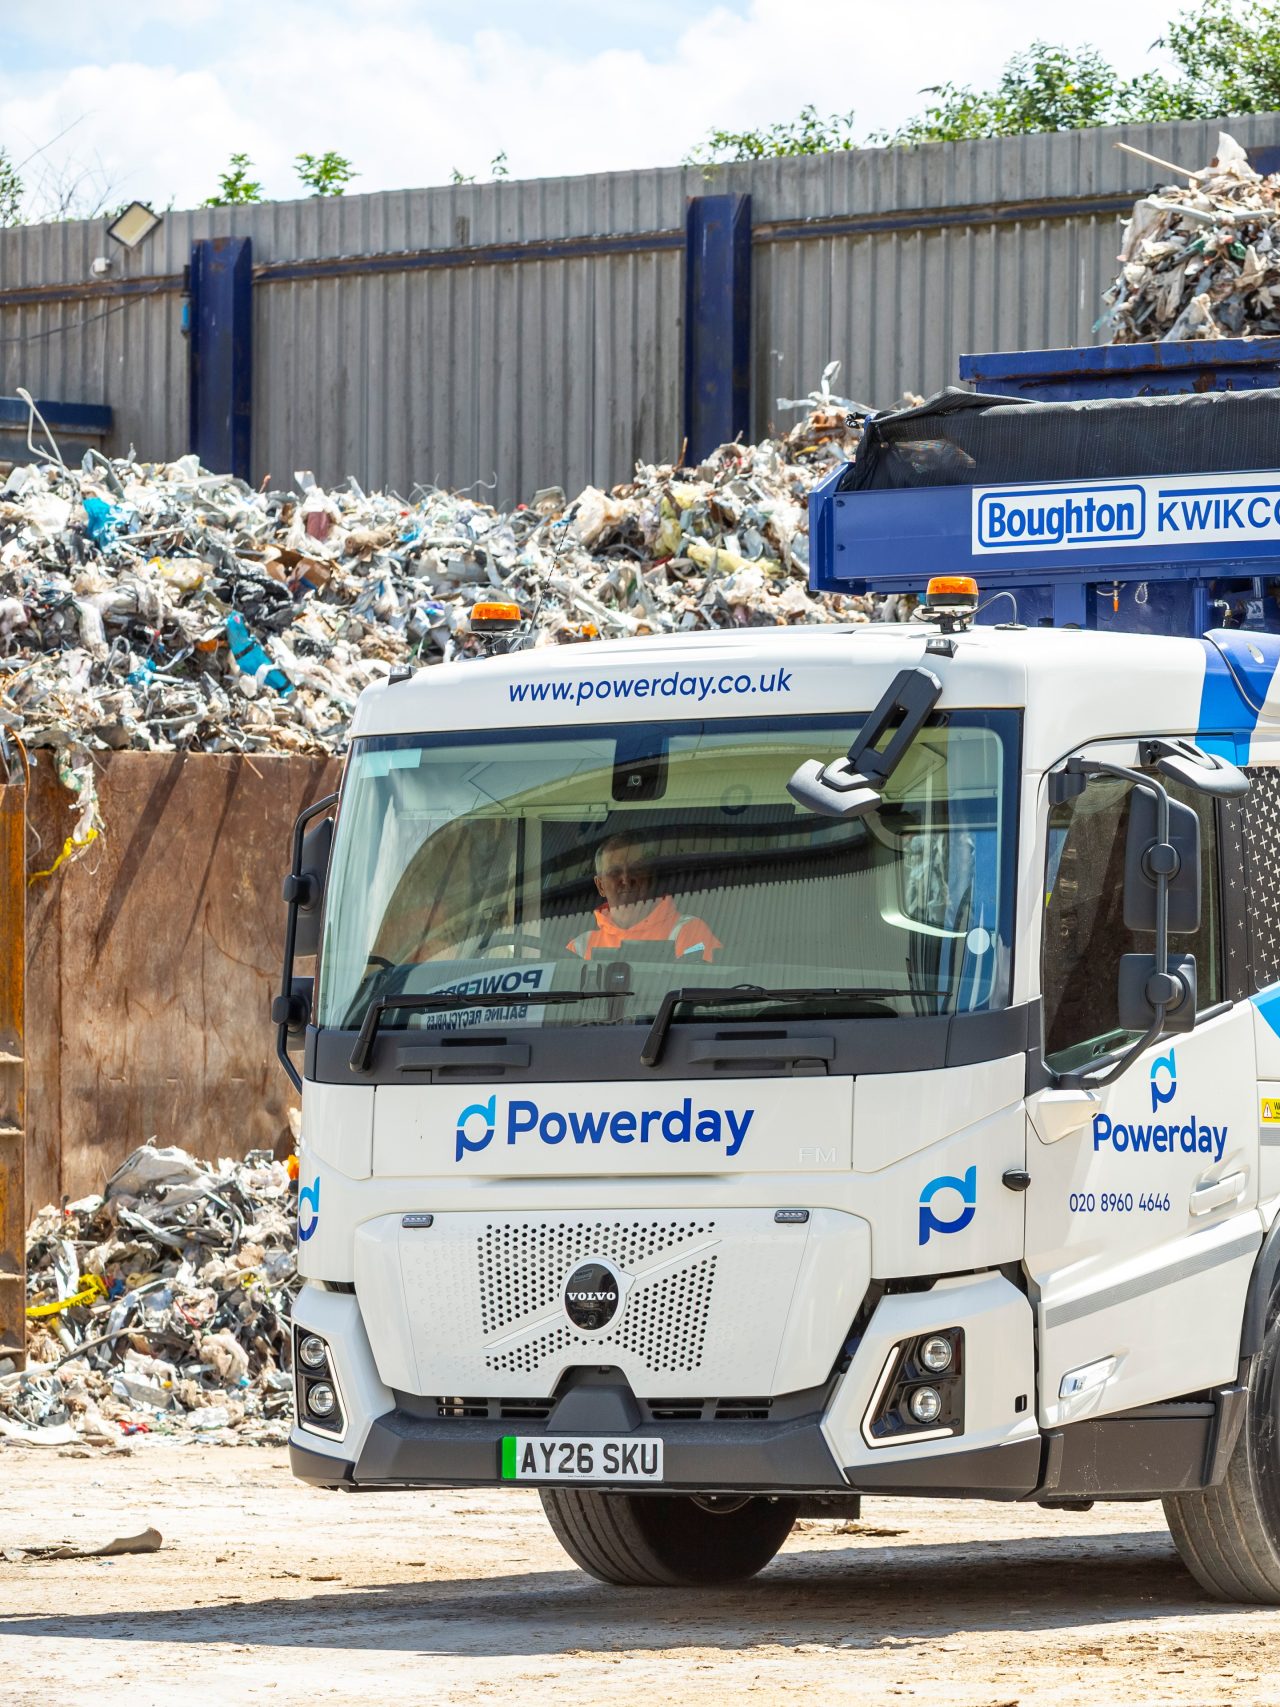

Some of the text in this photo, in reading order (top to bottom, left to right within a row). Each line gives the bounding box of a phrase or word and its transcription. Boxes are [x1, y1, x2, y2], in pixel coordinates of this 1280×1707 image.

[988, 498, 1134, 540] Boughton
[509, 668, 792, 706] www.powerday.co.uk
[507, 1097, 755, 1156] Powerday
[1092, 1113, 1228, 1164] Powerday
[798, 1146, 837, 1163] FM
[1069, 1192, 1170, 1212] 020 8960 4646
[567, 1291, 616, 1301] VOLVO
[520, 1442, 658, 1475] AY26 SKU
